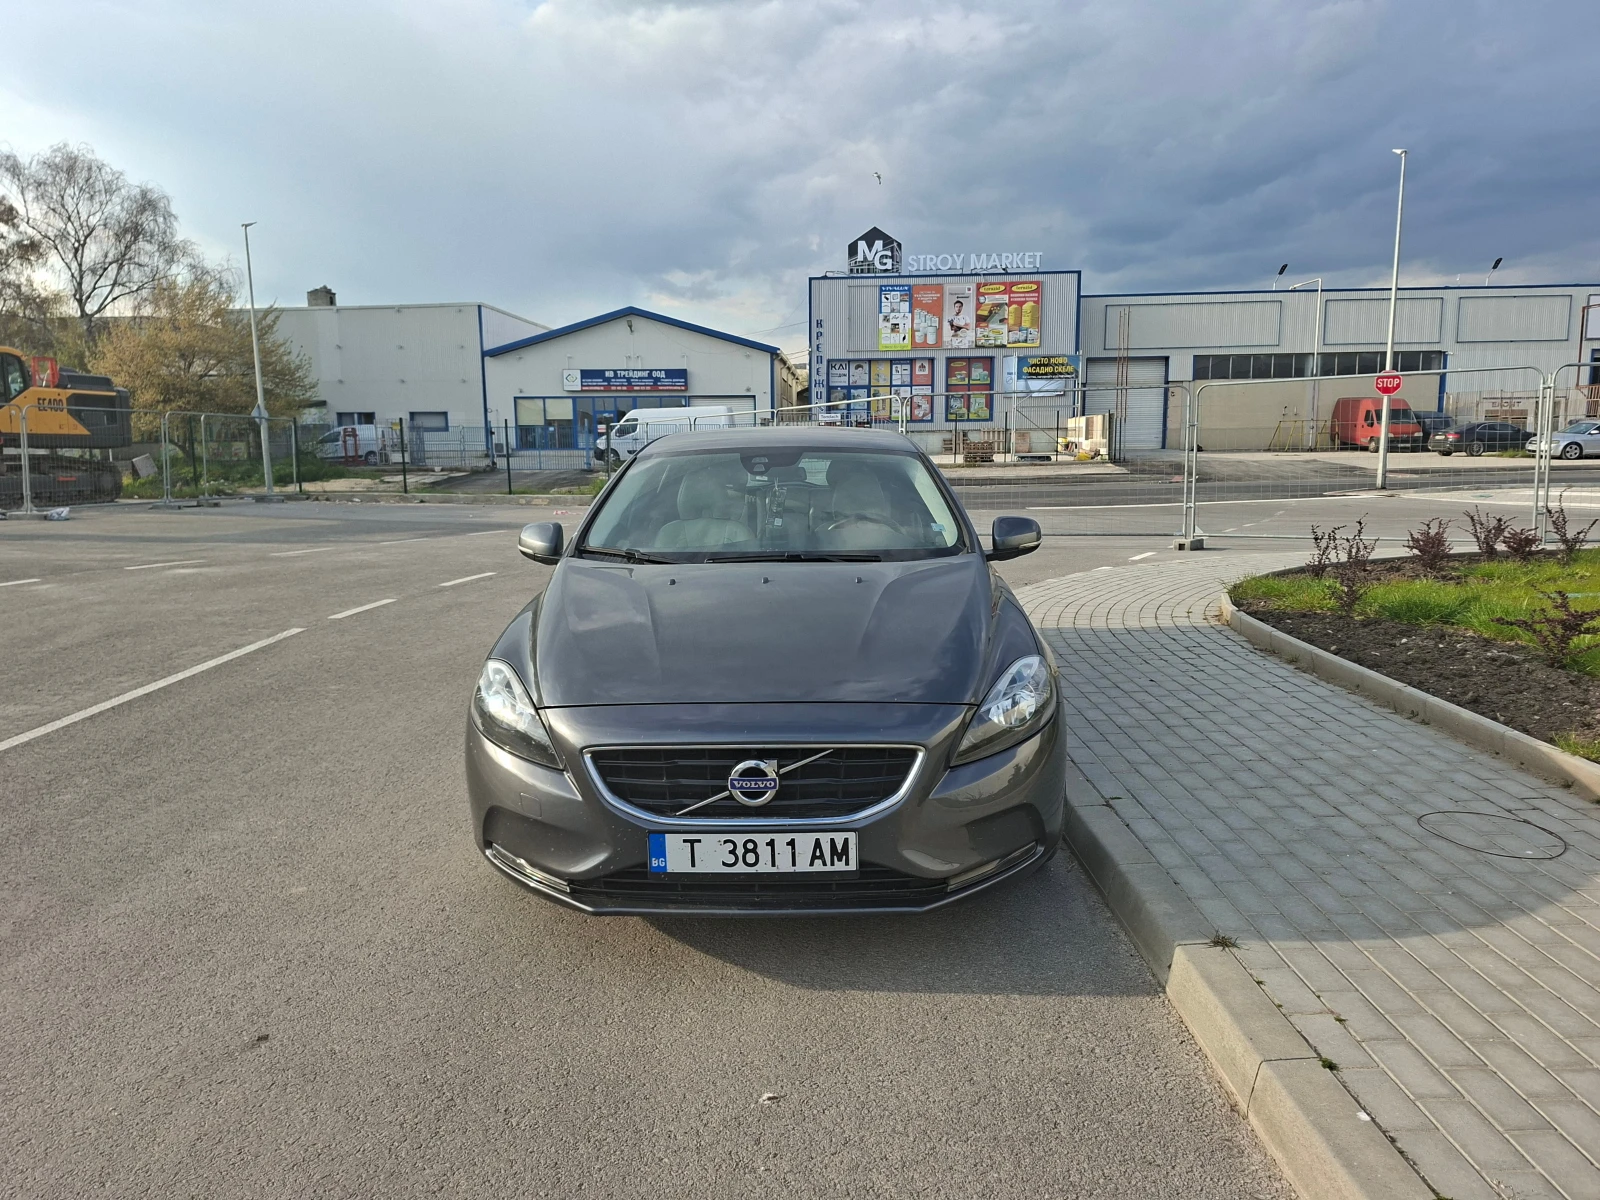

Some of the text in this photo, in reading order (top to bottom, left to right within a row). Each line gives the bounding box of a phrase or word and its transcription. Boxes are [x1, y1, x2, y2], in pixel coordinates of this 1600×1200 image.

[857, 240, 893, 270] MG
[908, 252, 1043, 272] STROY MARKET
[830, 363, 847, 371] KAI
[617, 370, 650, 378] ТРЕЙДИНГ
[1377, 378, 1400, 388] STOP
[732, 780, 775, 788] VOLVO
[651, 837, 850, 868] BG T 3811 AM
